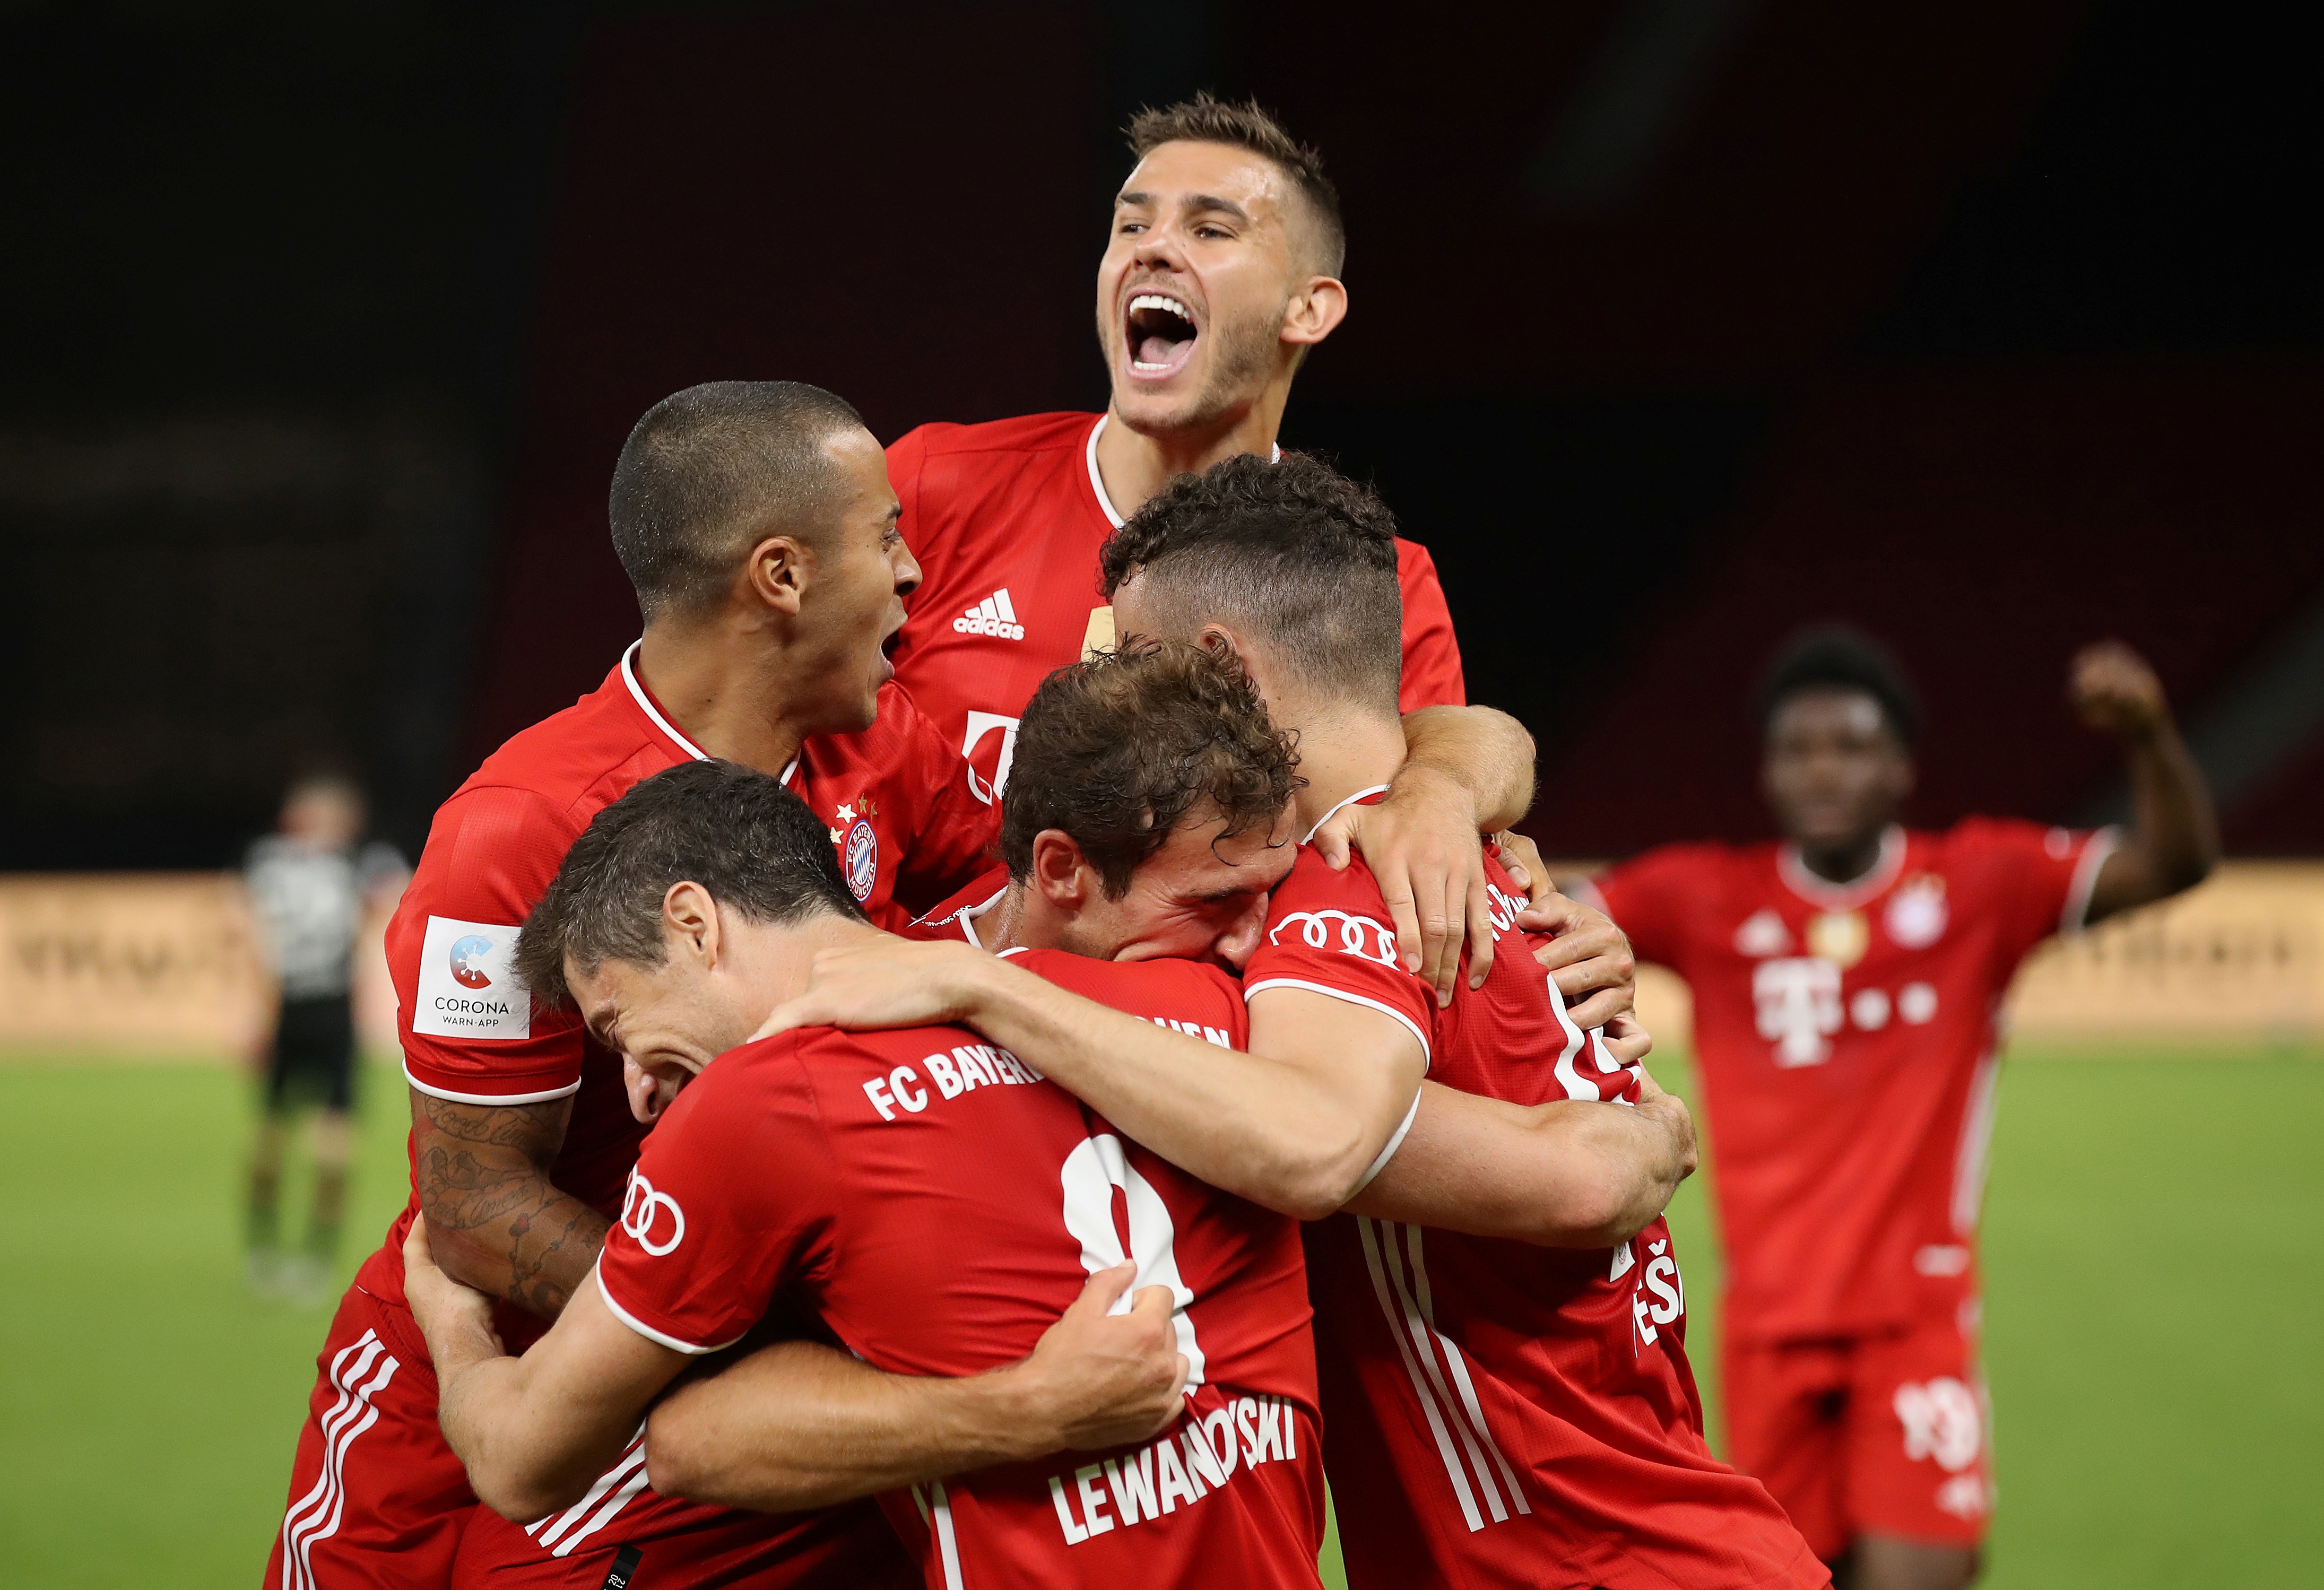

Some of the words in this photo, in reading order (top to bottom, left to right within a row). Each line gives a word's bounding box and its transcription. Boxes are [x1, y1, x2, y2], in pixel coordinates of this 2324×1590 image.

[952, 615, 1025, 641] adidas
[848, 844, 854, 863] FC
[853, 826, 874, 849] BAYERN
[435, 997, 509, 1014] CORONA
[443, 1015, 499, 1027] WARN-APP
[862, 1065, 929, 1121] FC
[608, 1574, 619, 1586] 20
